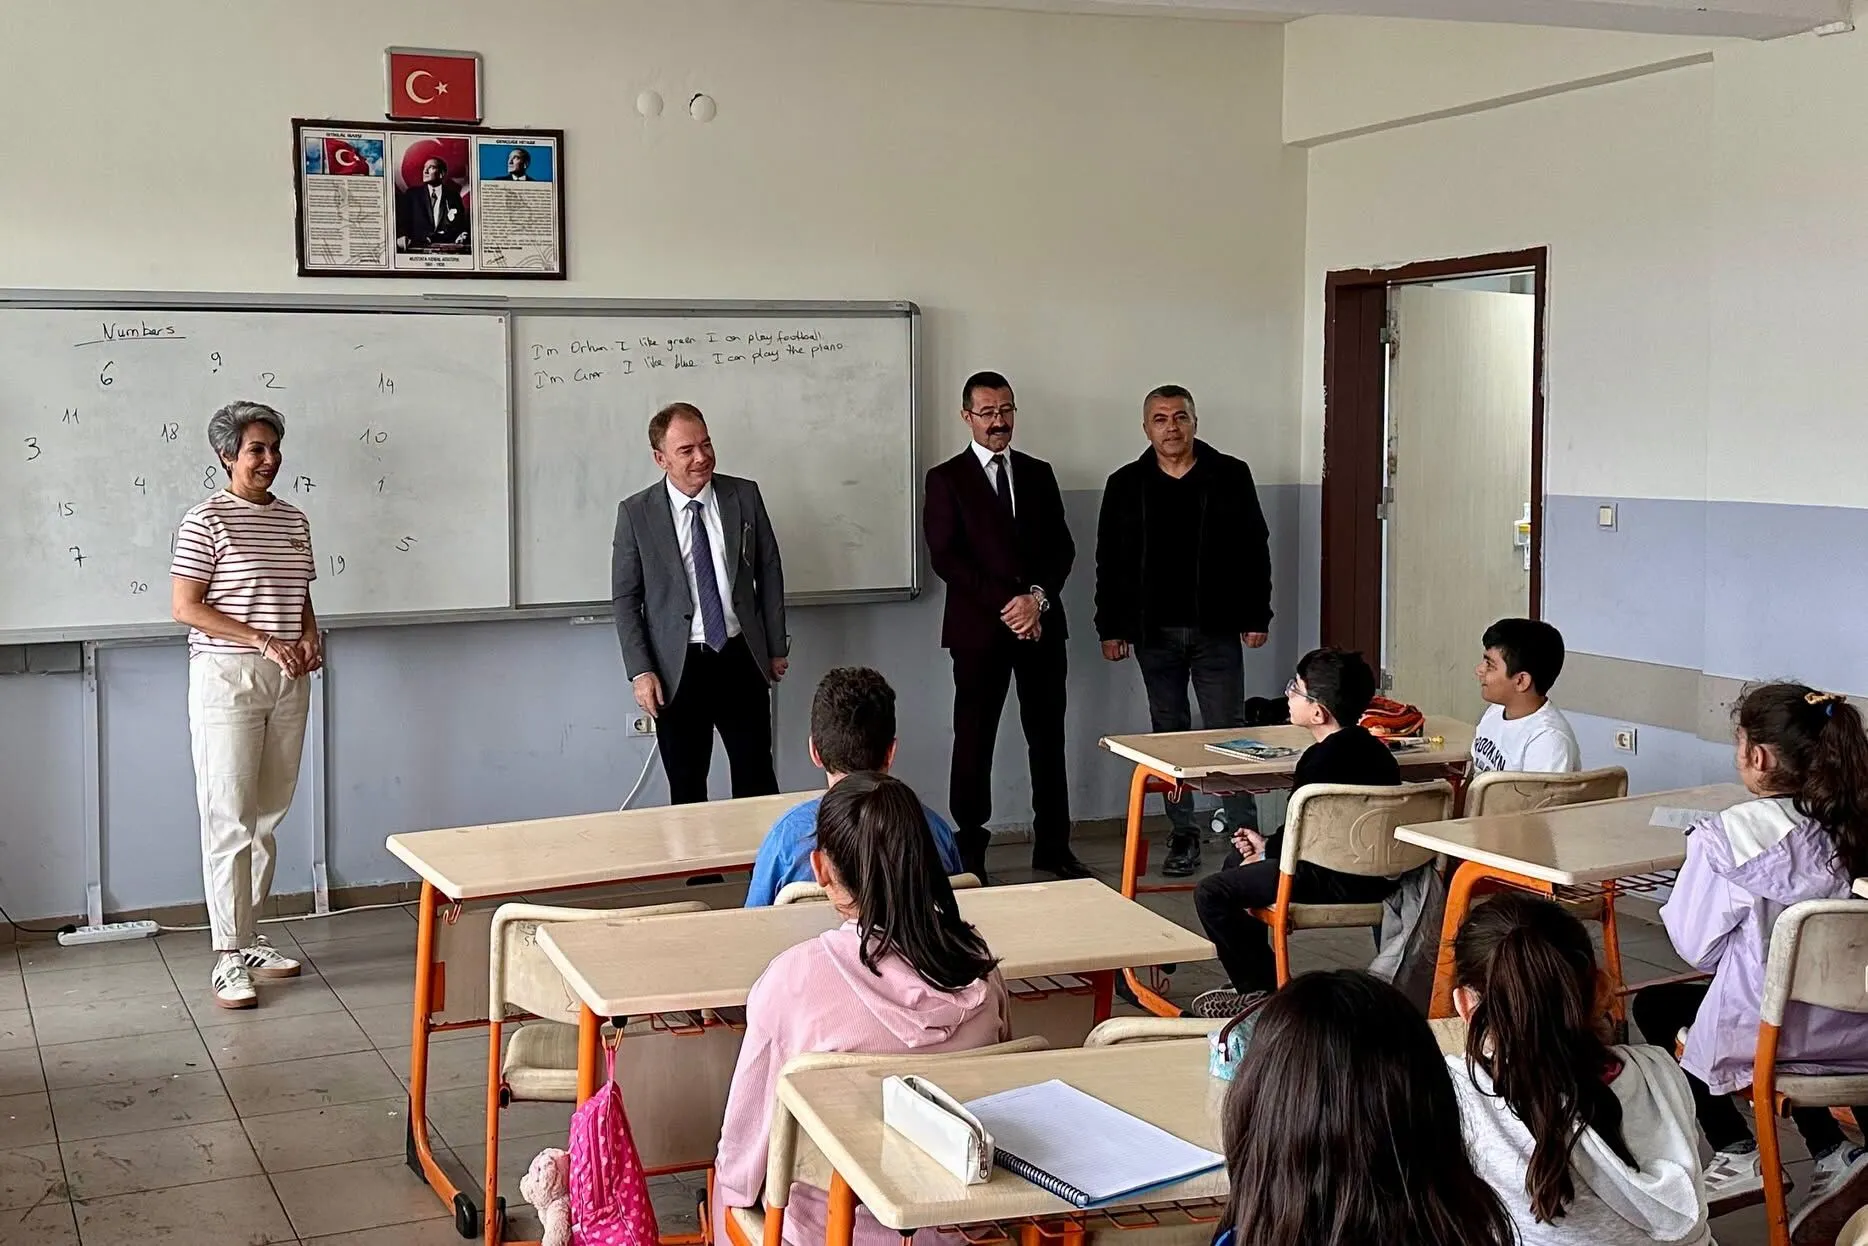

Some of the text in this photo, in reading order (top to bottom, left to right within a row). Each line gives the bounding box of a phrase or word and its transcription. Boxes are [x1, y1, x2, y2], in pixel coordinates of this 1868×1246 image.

[102, 320, 175, 339] Numbers
[639, 336, 660, 348] like
[748, 330, 773, 345] play
[210, 352, 222, 367] 9
[533, 370, 565, 389] I'm
[644, 355, 665, 369] like
[752, 347, 779, 365] play
[786, 344, 805, 355] the
[100, 360, 114, 386] 6
[261, 372, 287, 389] 2
[62, 407, 80, 424] 11
[161, 422, 179, 443] 18
[359, 428, 388, 445] 10
[24, 436, 41, 461] 3
[134, 476, 146, 495] 4
[203, 465, 217, 490] 8
[293, 475, 317, 493] 17
[58, 501, 76, 517] 15
[69, 546, 87, 568] 7
[329, 555, 346, 577] 19
[130, 580, 148, 595] 20
